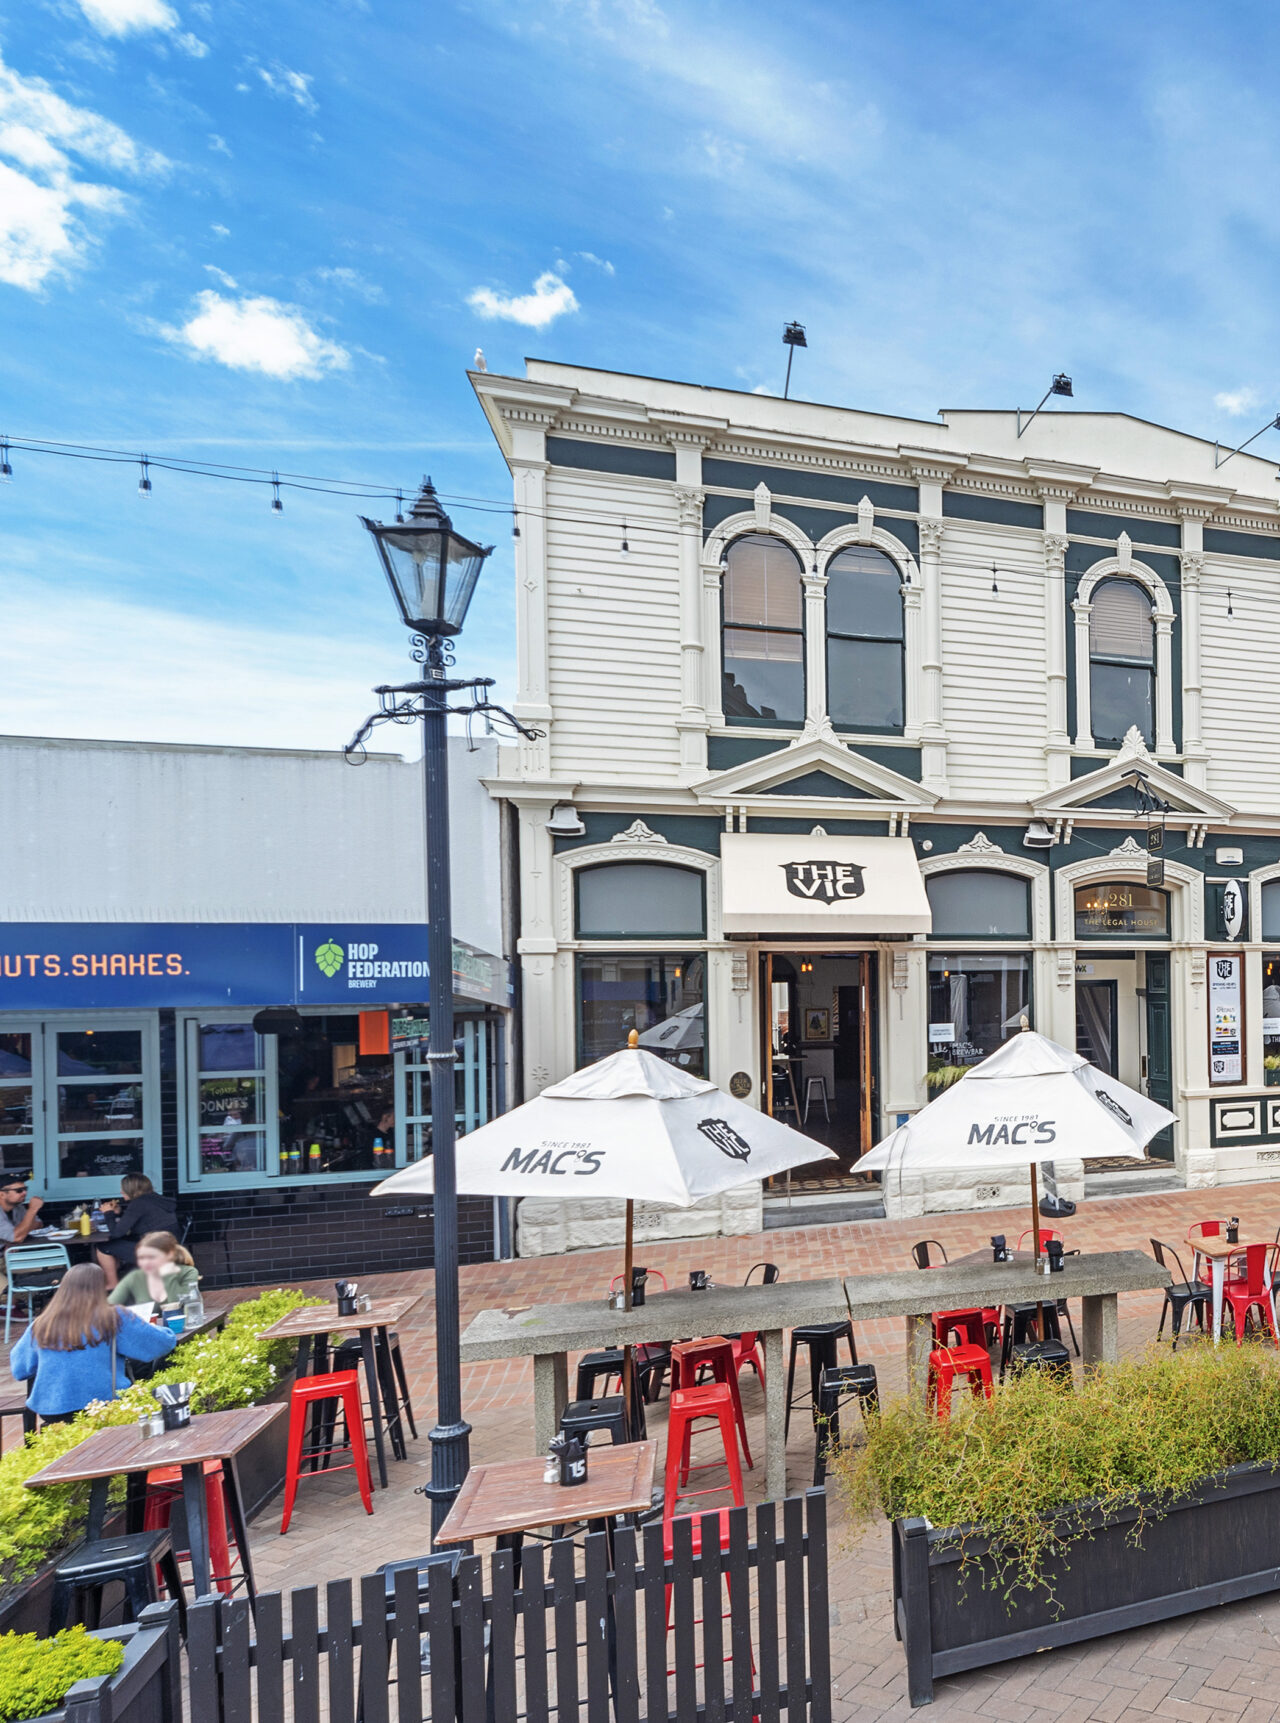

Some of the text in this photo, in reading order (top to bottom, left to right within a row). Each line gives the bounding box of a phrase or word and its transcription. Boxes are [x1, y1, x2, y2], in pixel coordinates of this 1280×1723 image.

[792, 864, 855, 880] THE
[792, 878, 857, 897] VIC
[1109, 893, 1133, 907] 281
[348, 943, 378, 960] HOP
[0, 953, 191, 977] UTS.SHAKES.
[348, 961, 430, 978] FEDERATION
[348, 980, 377, 988] BREWERY
[701, 1123, 731, 1141] THE
[967, 1121, 1056, 1145] MAC'S
[541, 1141, 569, 1149] SINCE
[715, 1133, 750, 1156] VIC
[500, 1147, 606, 1175] MAC'S
[569, 1459, 585, 1478] 15
